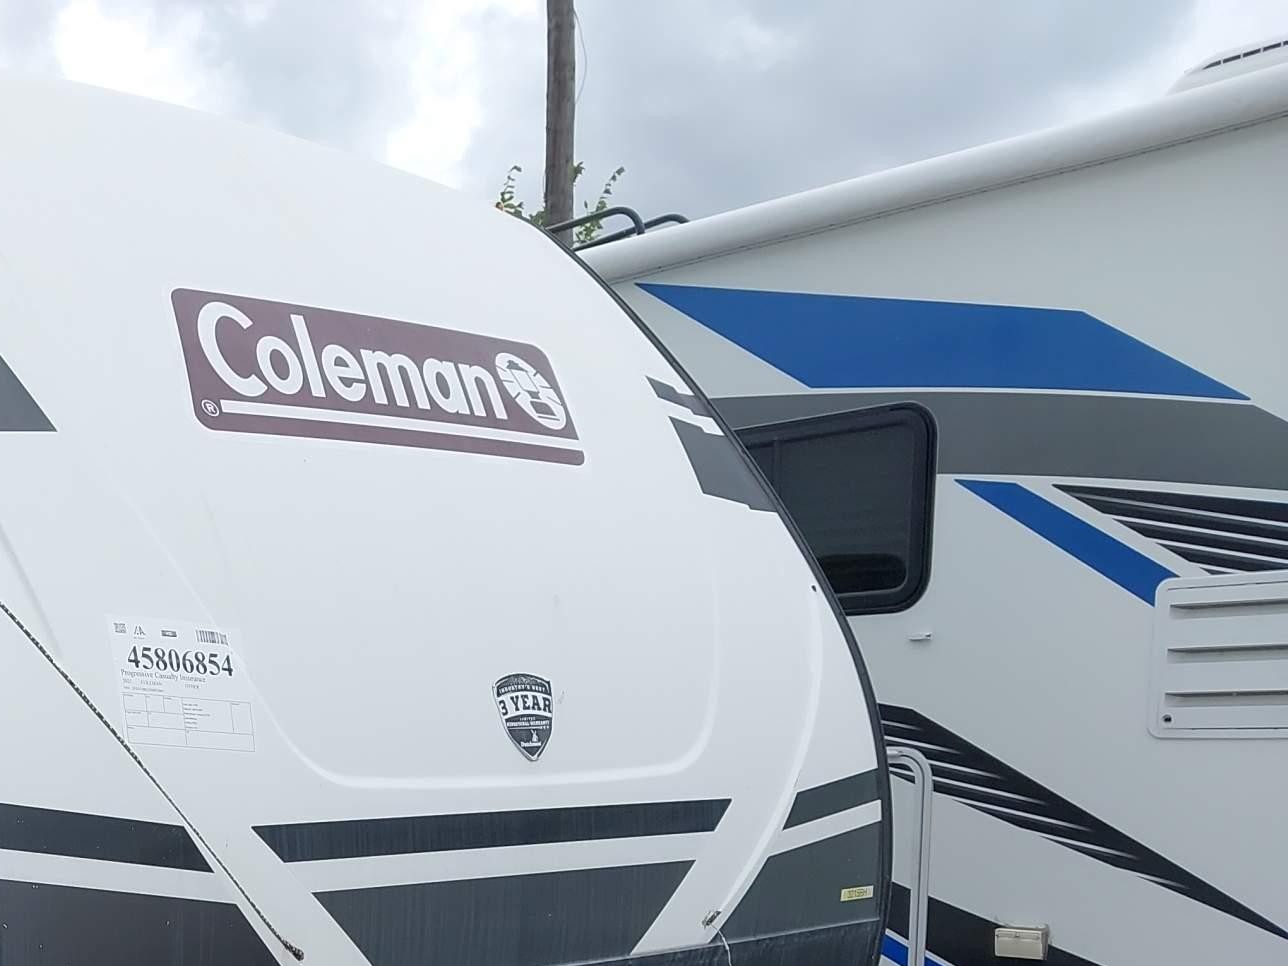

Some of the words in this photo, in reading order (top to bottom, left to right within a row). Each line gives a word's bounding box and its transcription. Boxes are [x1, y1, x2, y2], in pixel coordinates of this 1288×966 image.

[197, 300, 509, 420] Coleman
[127, 645, 233, 677] 45806854
[121, 668, 153, 680] Progressive
[154, 671, 179, 682] Casualty
[498, 699, 508, 716] 3
[510, 694, 552, 713] YEAR
